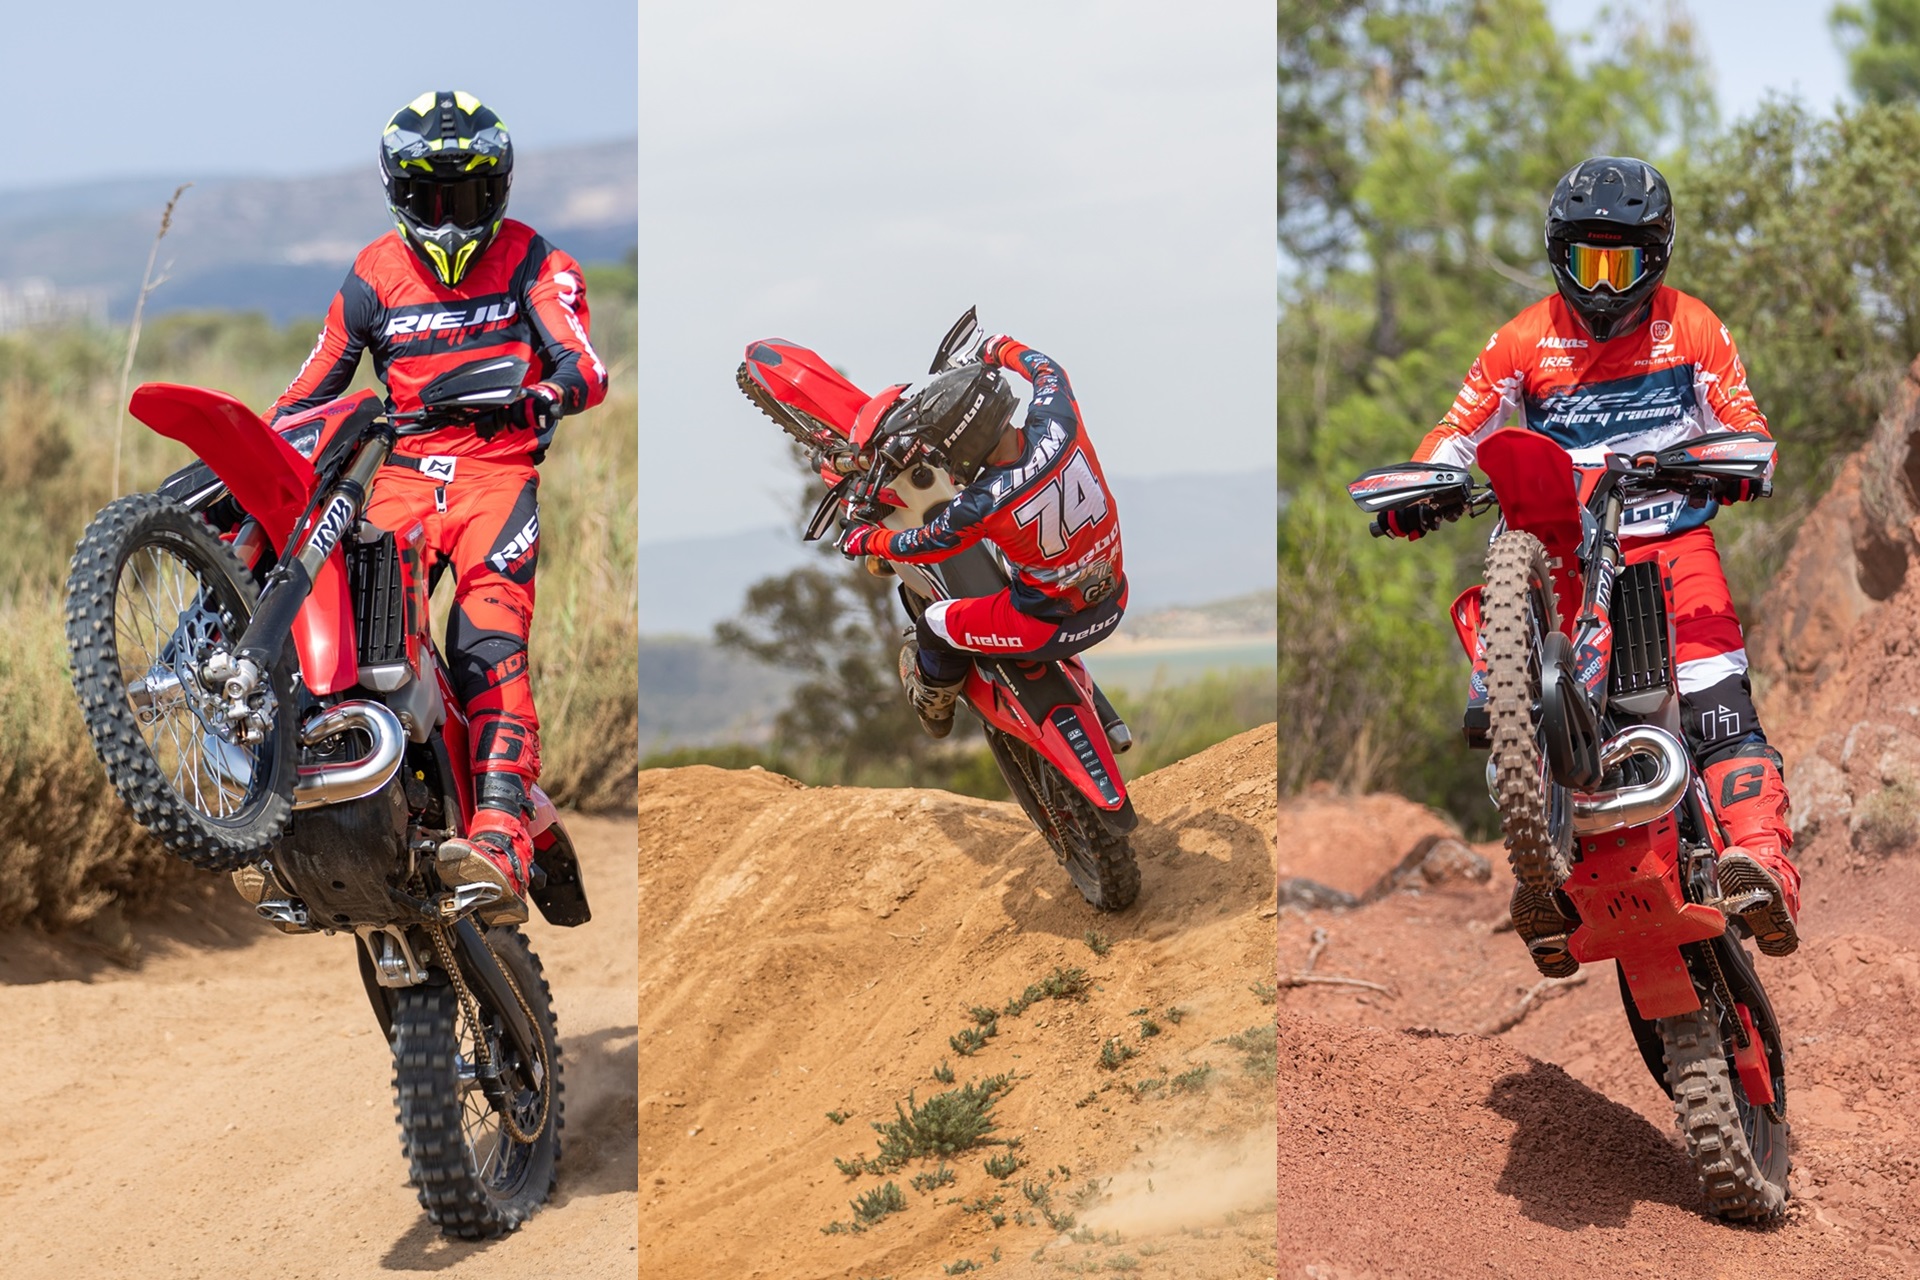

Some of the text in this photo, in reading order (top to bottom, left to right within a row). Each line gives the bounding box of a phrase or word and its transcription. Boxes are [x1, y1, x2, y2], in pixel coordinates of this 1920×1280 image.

[385, 301, 517, 336] RIEJU
[1540, 356, 1575, 368] IRIS
[943, 393, 985, 449] hebo
[1616, 405, 1681, 423] racing
[990, 418, 1068, 506] LIAM
[1700, 444, 1737, 456] HARD
[1383, 474, 1421, 482] HARD
[1011, 445, 1108, 560] 74
[308, 496, 354, 559] KYB
[490, 504, 540, 573] RIE
[965, 632, 1025, 648] hebo
[1059, 612, 1119, 643] hebo
